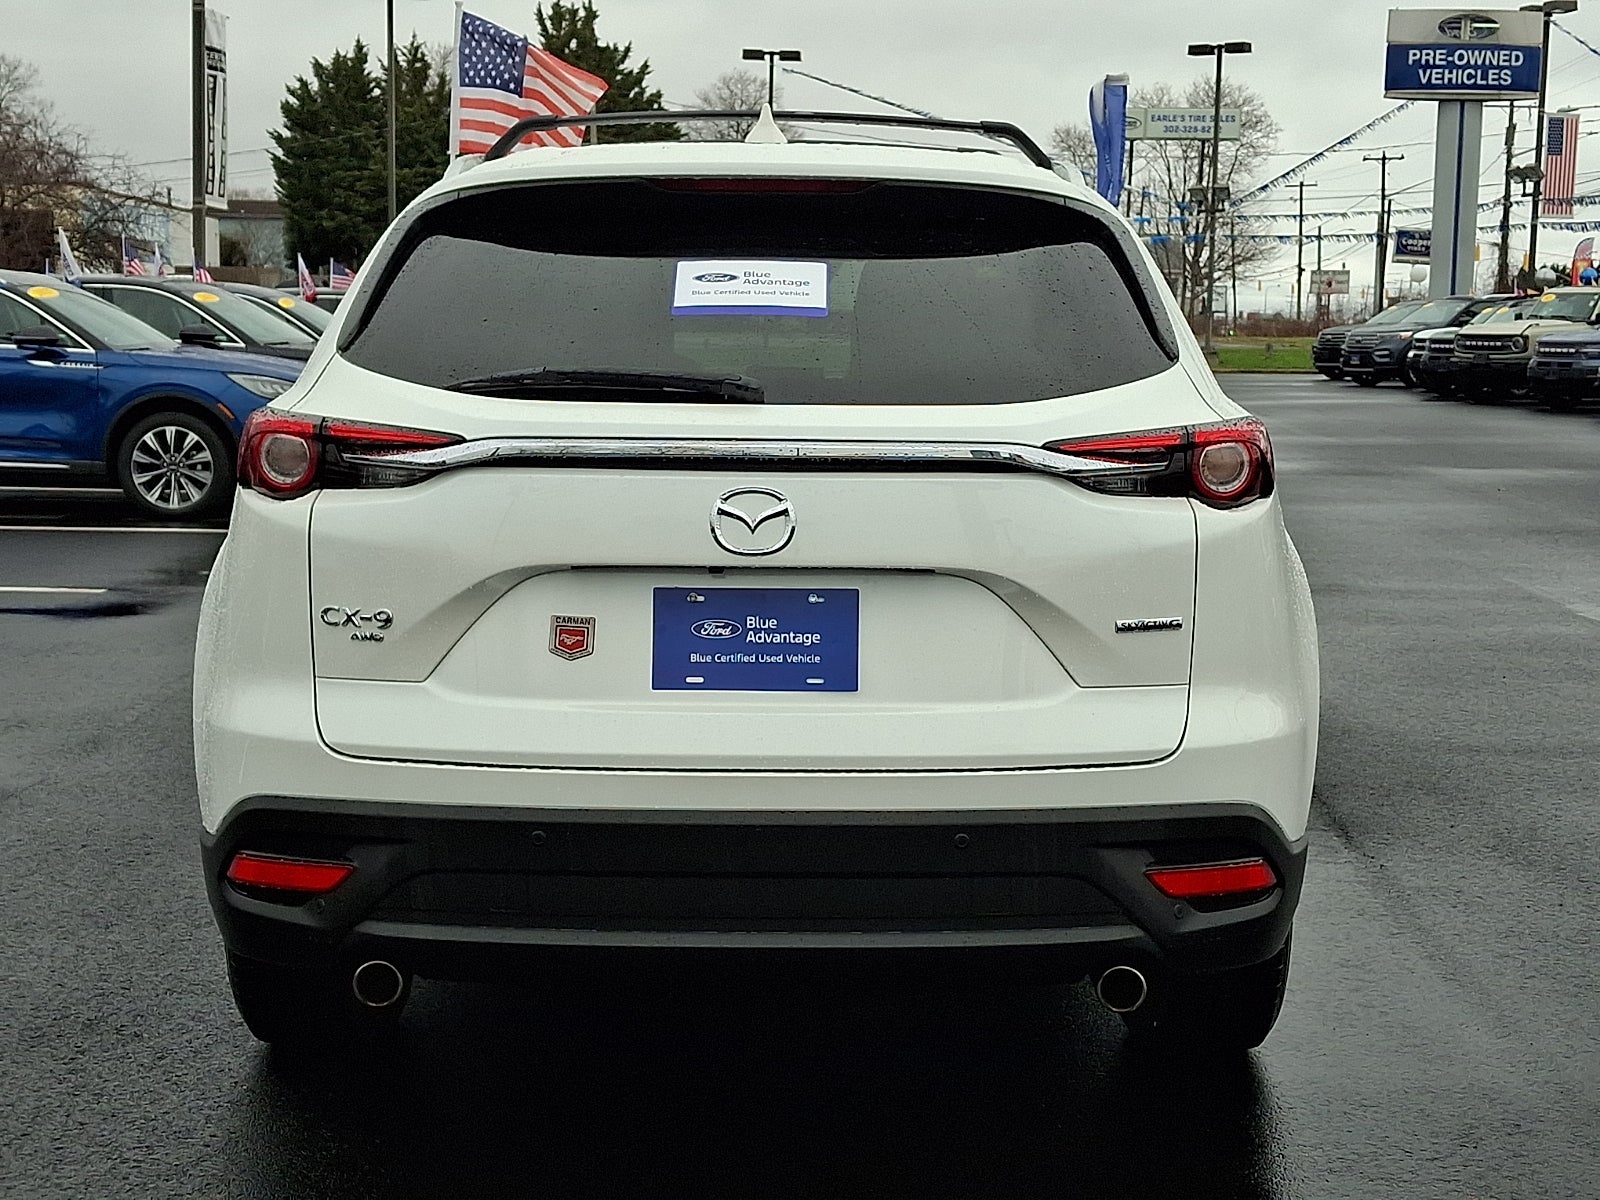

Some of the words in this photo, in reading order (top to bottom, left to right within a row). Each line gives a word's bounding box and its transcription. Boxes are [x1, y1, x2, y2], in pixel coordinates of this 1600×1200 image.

[1408, 49, 1524, 66] PRE-OWNED
[1418, 69, 1512, 85] VEHICLES
[1151, 114, 1186, 123] EARLE'S
[1188, 114, 1206, 123] TIRE
[1209, 114, 1236, 123] SLES
[701, 273, 731, 283] Ford
[743, 278, 810, 287] Advantage
[320, 606, 394, 630] CX-9
[555, 616, 591, 626] CARMAN
[746, 616, 778, 629] Blue
[701, 622, 733, 636] Ford
[350, 631, 384, 642] AWD
[745, 630, 821, 646] Advantage
[690, 653, 712, 663] Blue
[714, 653, 756, 663] Certified
[758, 653, 783, 663] Used
[786, 654, 821, 664] Vehicle
